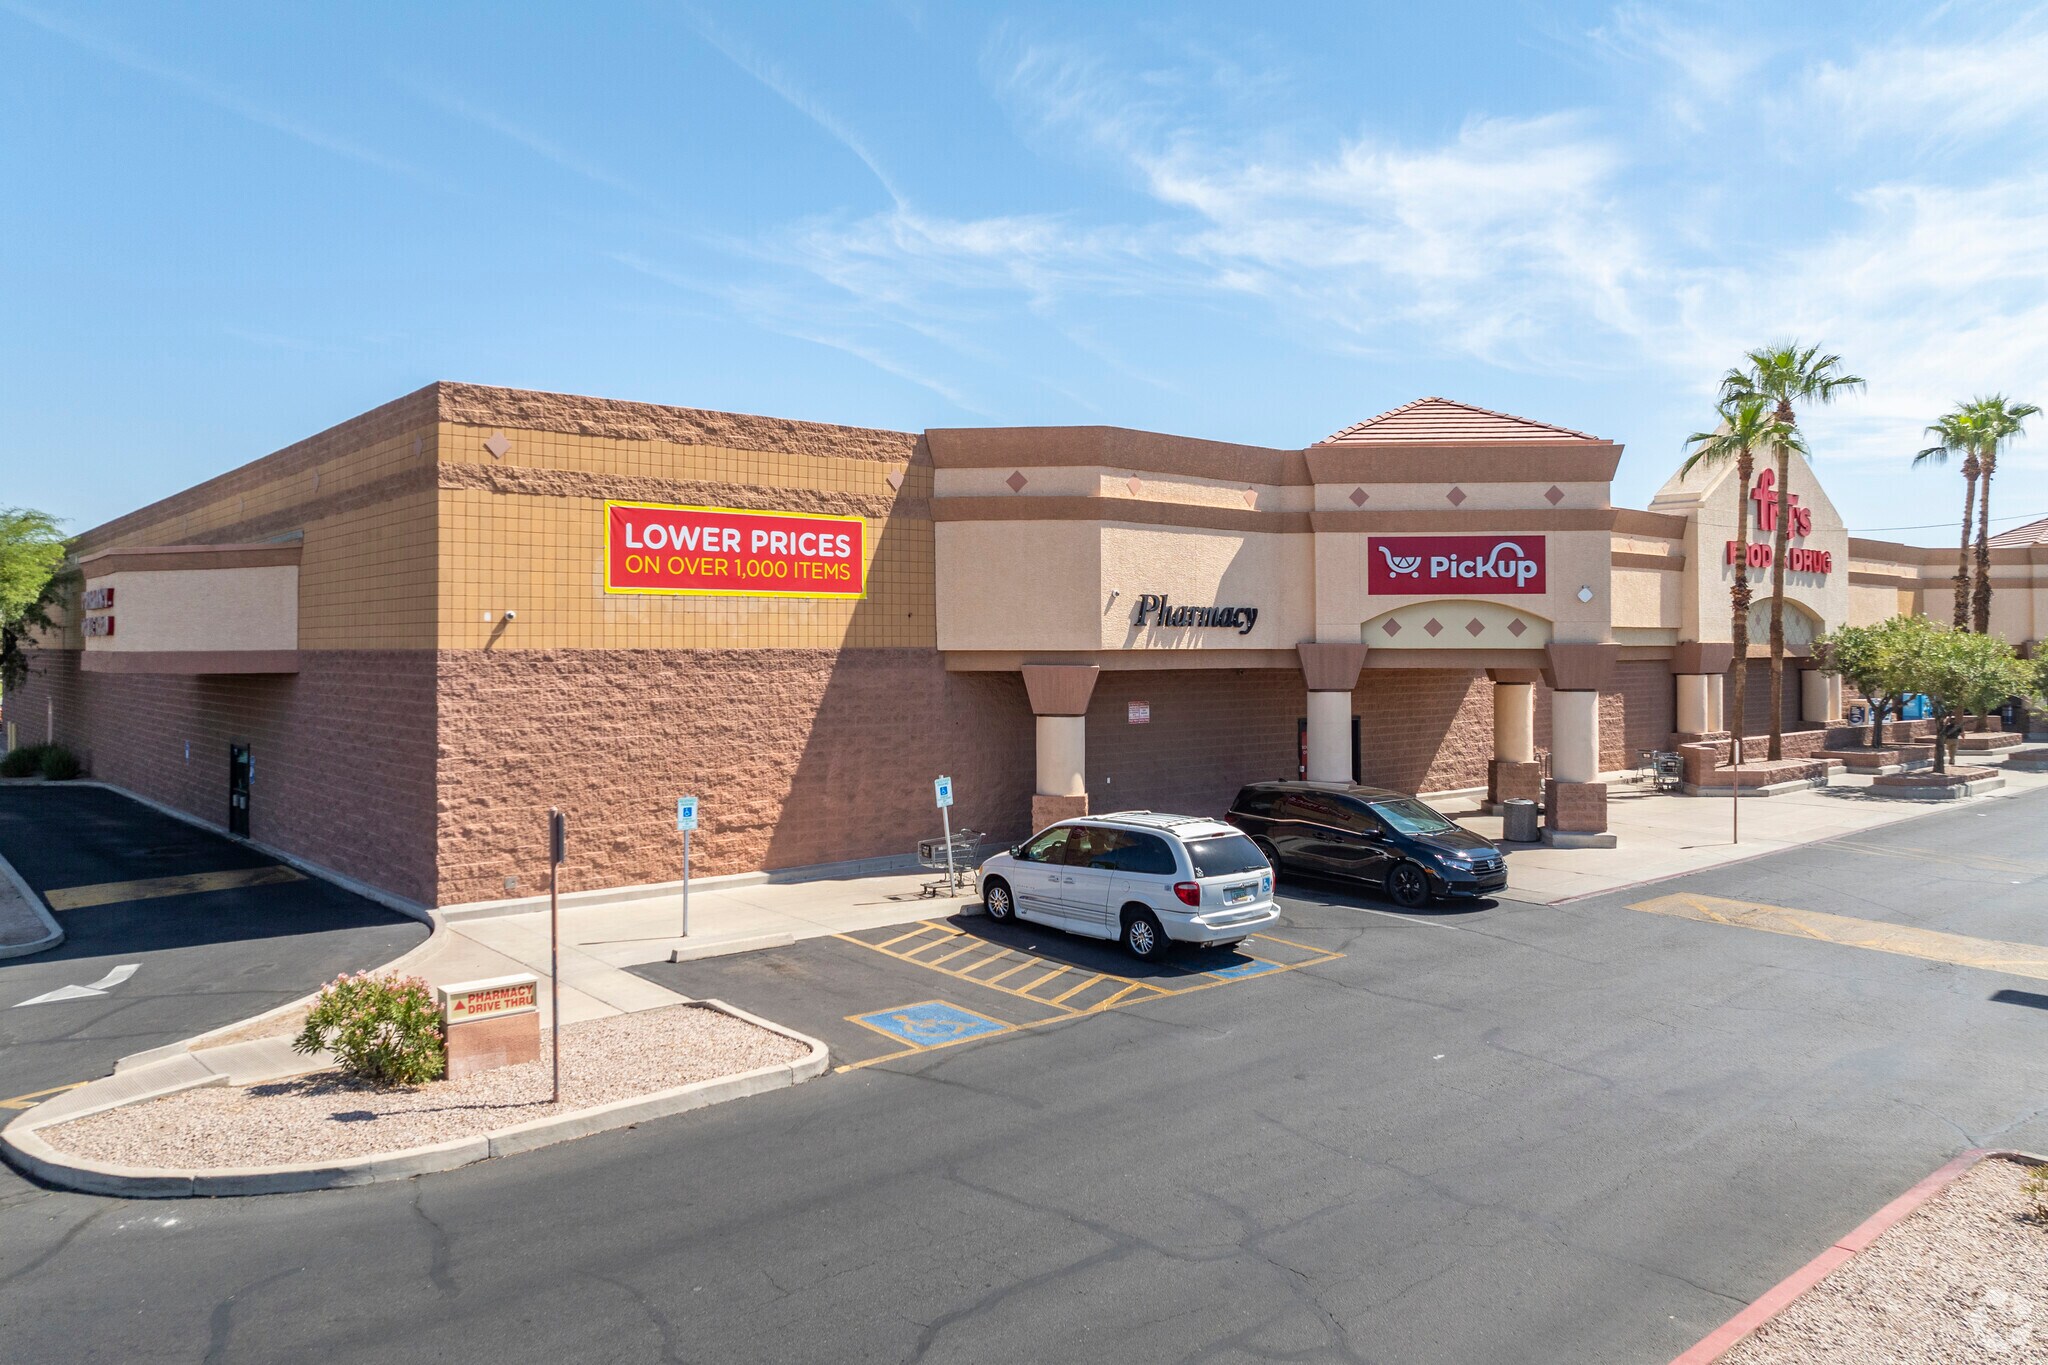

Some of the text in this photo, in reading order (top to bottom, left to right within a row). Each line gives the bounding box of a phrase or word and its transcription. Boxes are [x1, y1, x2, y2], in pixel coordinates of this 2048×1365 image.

[625, 522, 851, 558] LOWER PRICES
[625, 554, 851, 581] ON OVER 1,000 ITEMS
[1790, 548, 1832, 574] DRUG
[1133, 593, 1259, 635] Pharmacy
[468, 984, 534, 1004] PHARMACY
[468, 995, 534, 1015] DRIVE THRU
